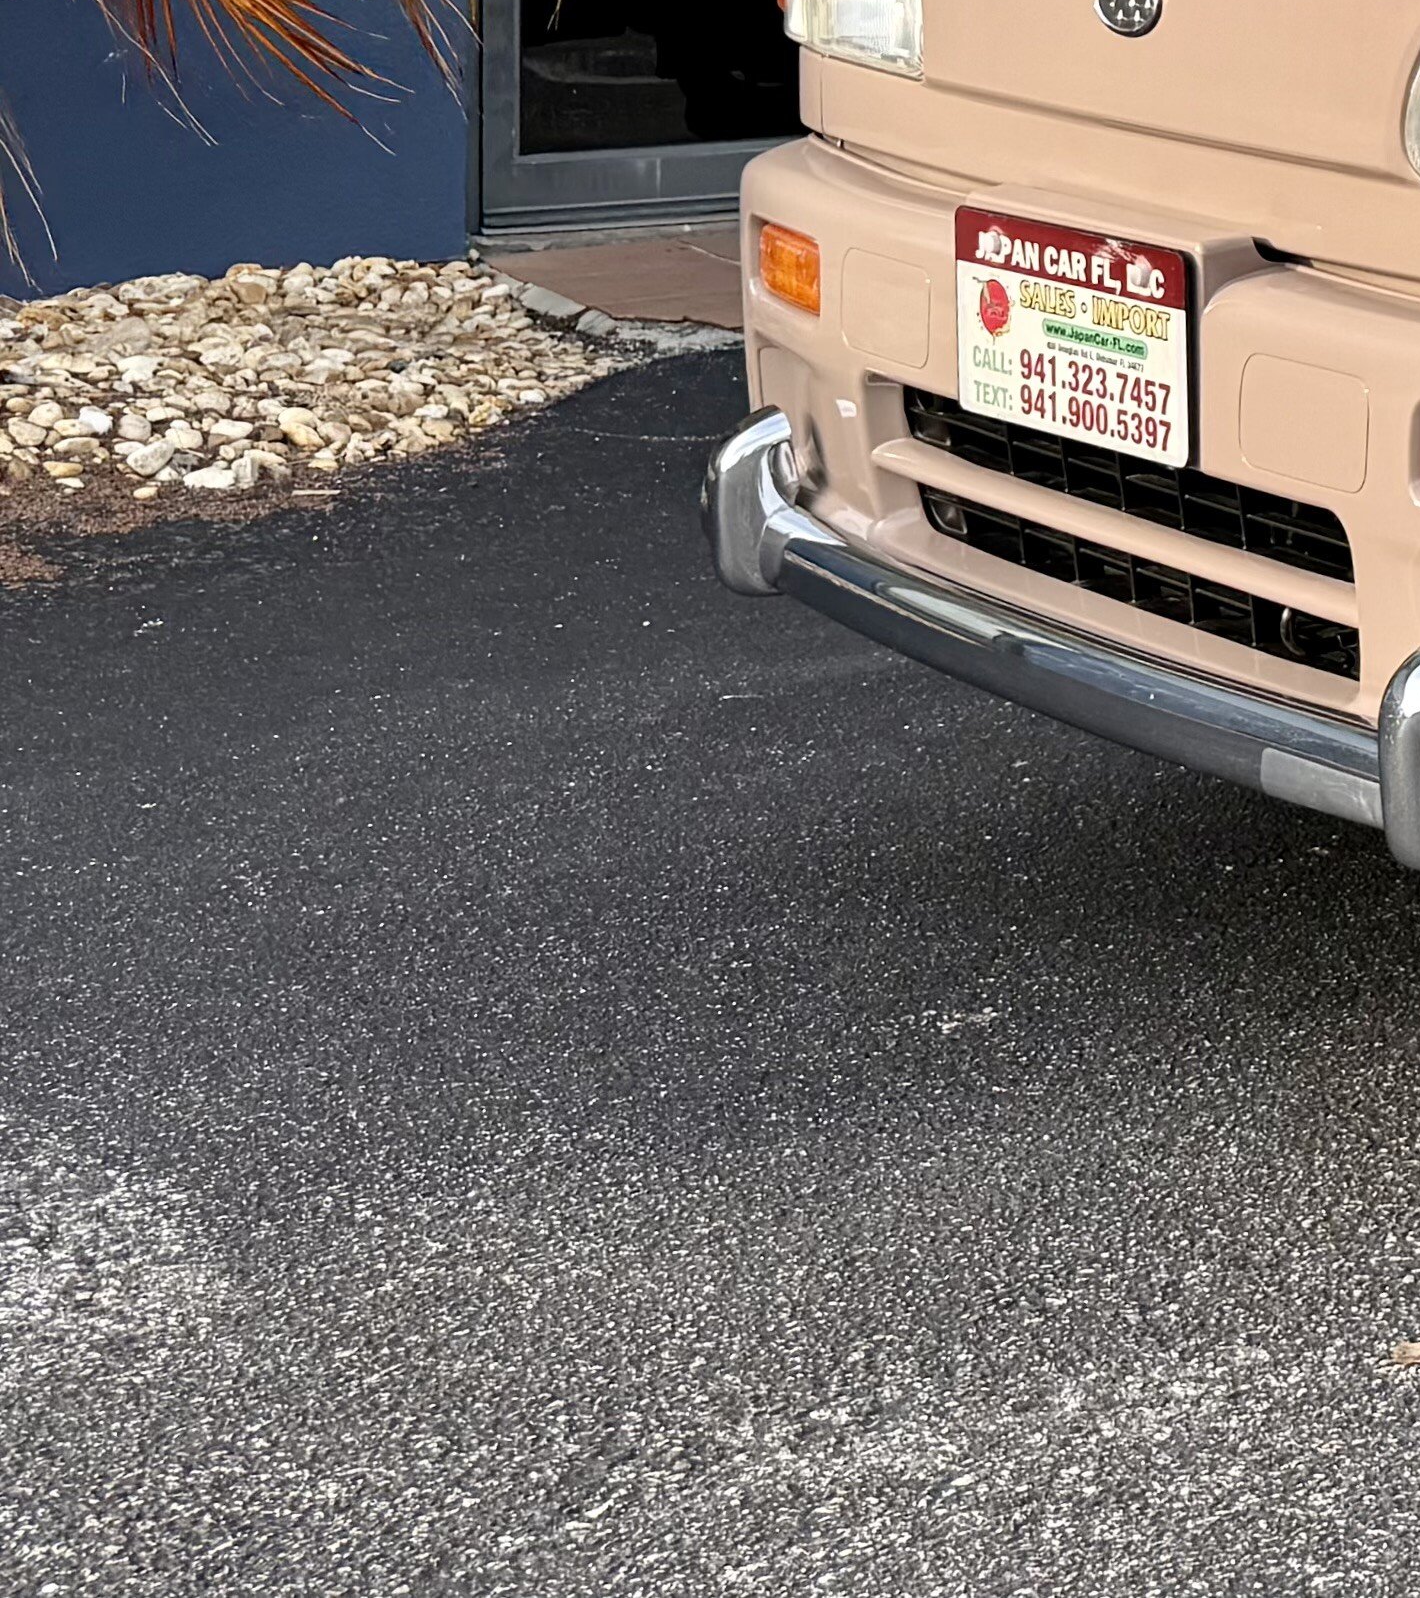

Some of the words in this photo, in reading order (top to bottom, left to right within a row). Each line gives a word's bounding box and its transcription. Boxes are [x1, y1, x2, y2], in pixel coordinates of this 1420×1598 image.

[1043, 246, 1087, 283] CAR
[1091, 256, 1122, 296] FL,
[1019, 280, 1076, 319] SALES
[1092, 295, 1170, 341] IMPORT
[1046, 323, 1145, 355] www.JapanCar-FL.com
[972, 345, 1013, 376] CALL:
[1020, 348, 1171, 416] 941.323.7457
[973, 380, 1013, 411] TEXT:
[1020, 384, 1172, 452] 941.900.5397
